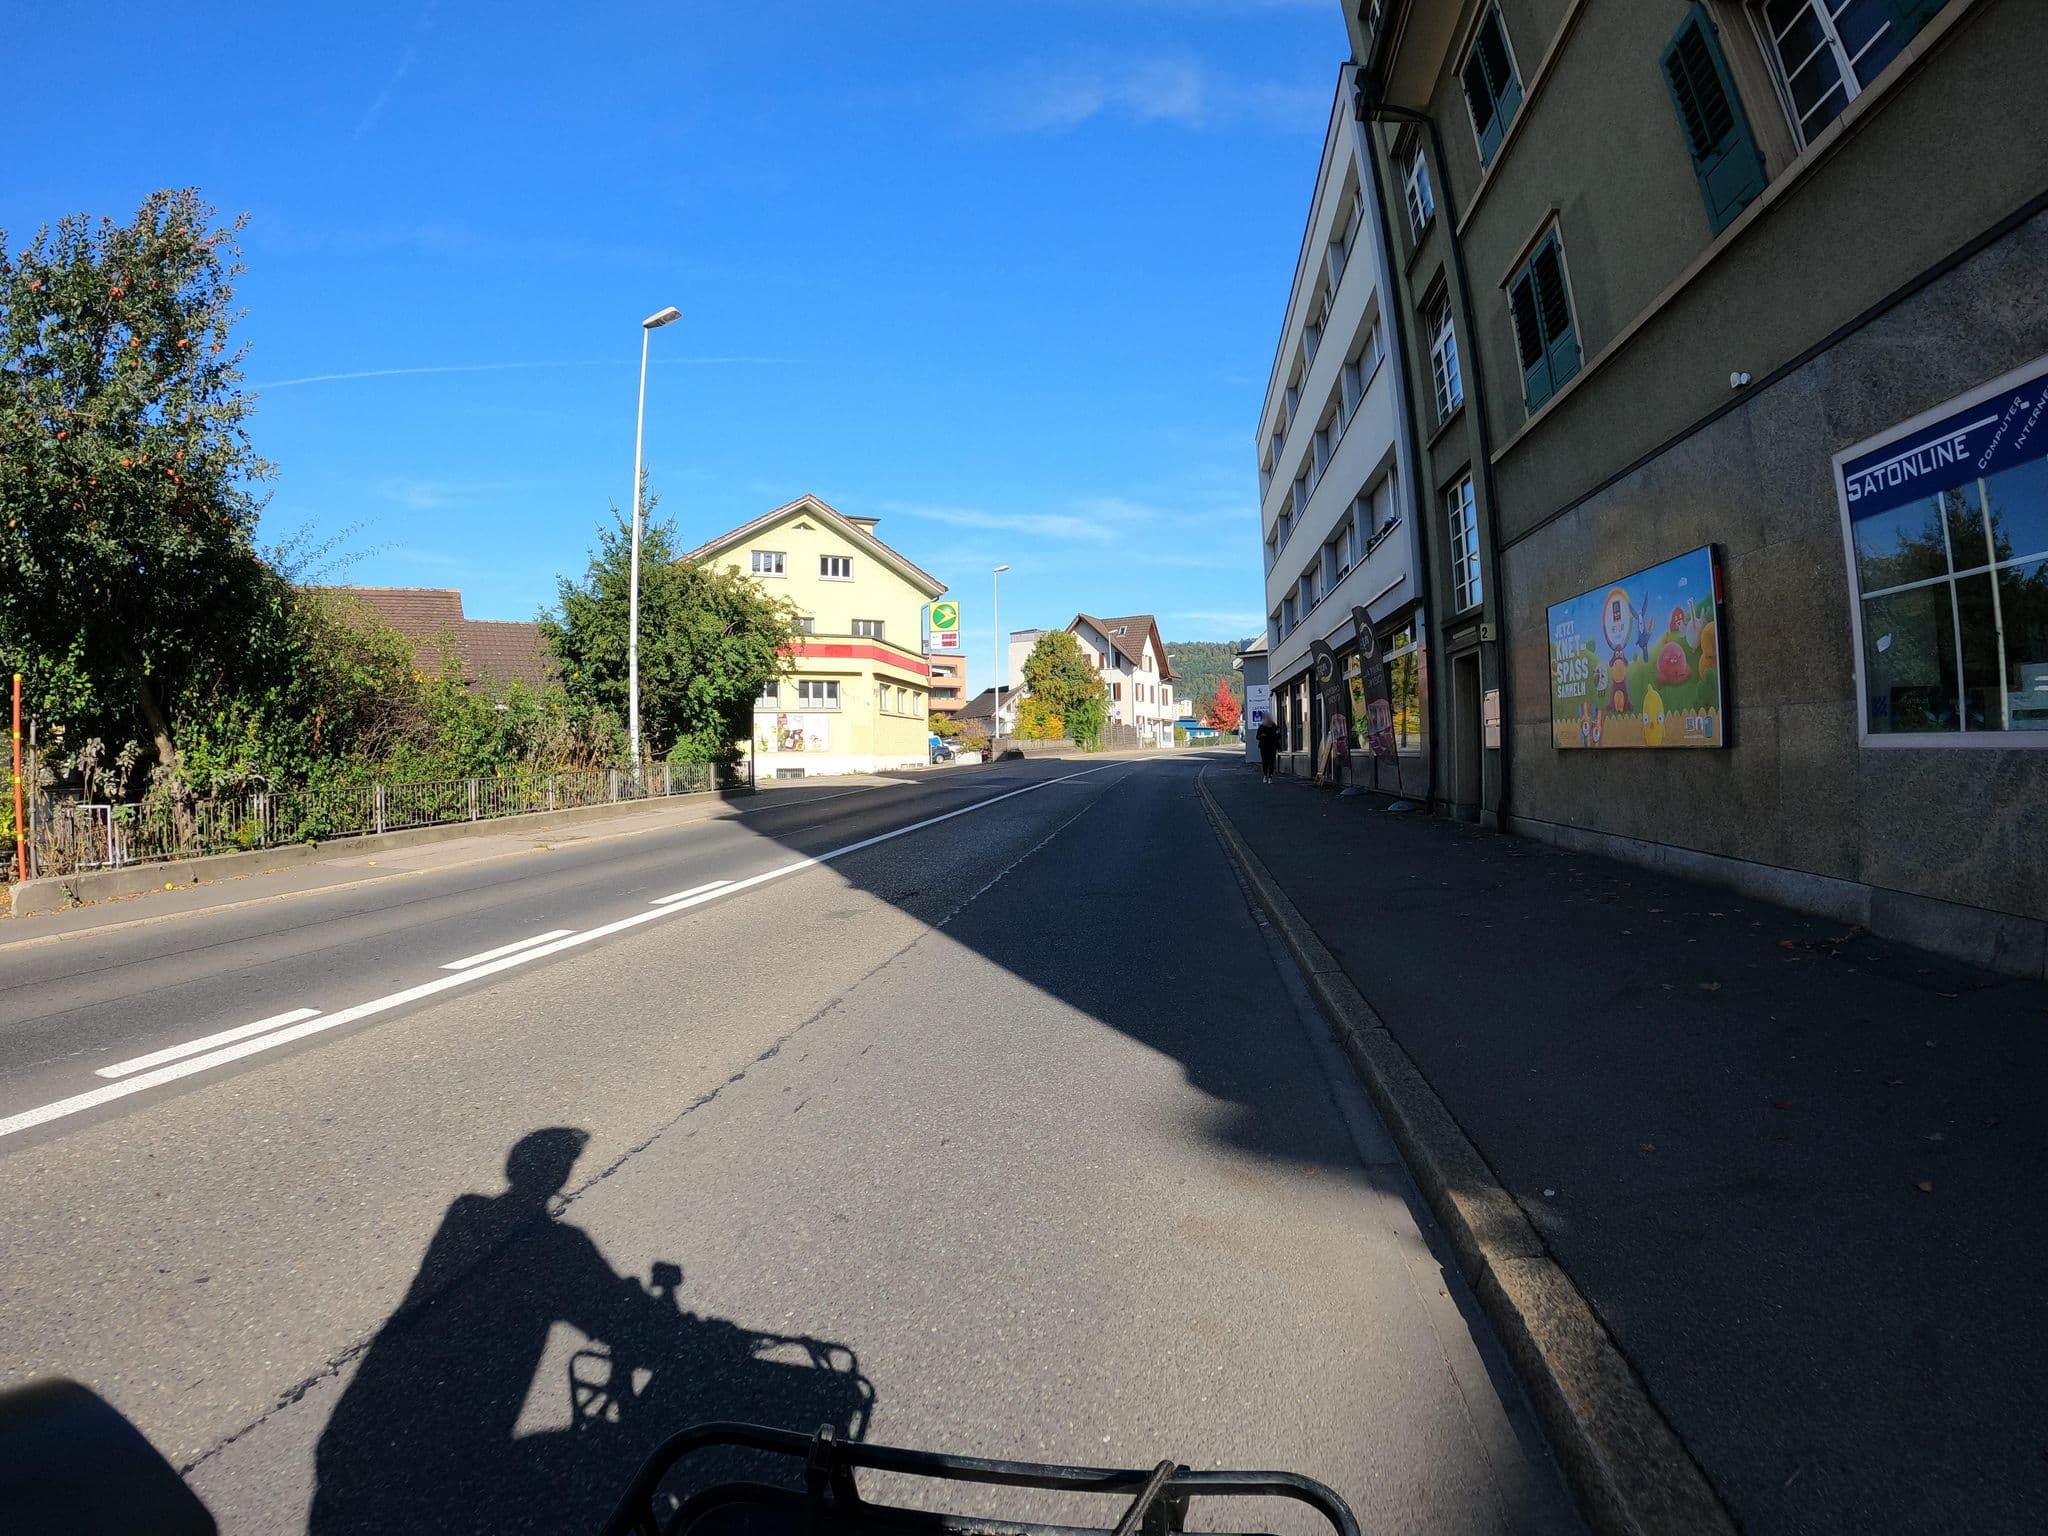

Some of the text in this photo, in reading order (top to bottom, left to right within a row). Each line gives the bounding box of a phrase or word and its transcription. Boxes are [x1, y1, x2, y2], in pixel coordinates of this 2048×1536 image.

[2014, 384, 2048, 450] INTERNE
[1977, 396, 2022, 470] COMPUTER
[1846, 431, 1971, 502] SATONLINE
[1481, 627, 1488, 639] 2
[1556, 622, 1575, 639] JETZT
[1557, 657, 1588, 684] SPASS
[1557, 682, 1586, 697] SAMMELN
